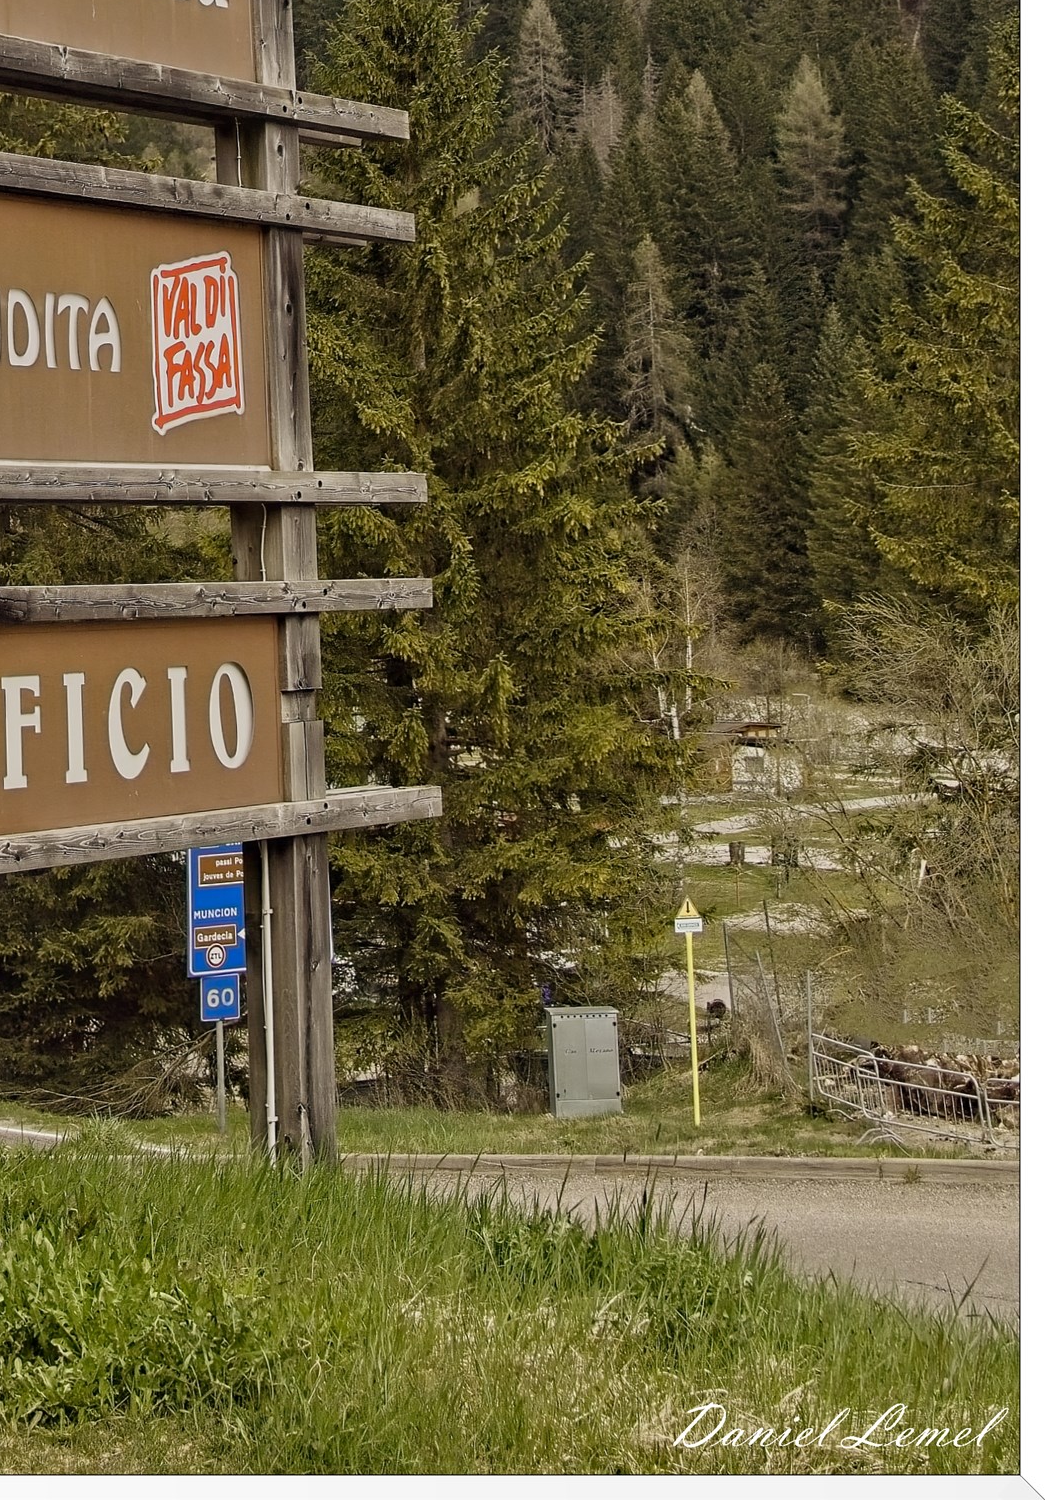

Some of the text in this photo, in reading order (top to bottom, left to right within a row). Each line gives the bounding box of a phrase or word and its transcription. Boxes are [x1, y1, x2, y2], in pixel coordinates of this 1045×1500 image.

[164, 333, 232, 408] FASSA
[215, 857, 232, 868] passi
[225, 870, 234, 879] de
[193, 907, 238, 920] MUNCION
[196, 930, 233, 943] Gardecia
[210, 952, 222, 960] ZTL
[207, 988, 235, 1008] 60
